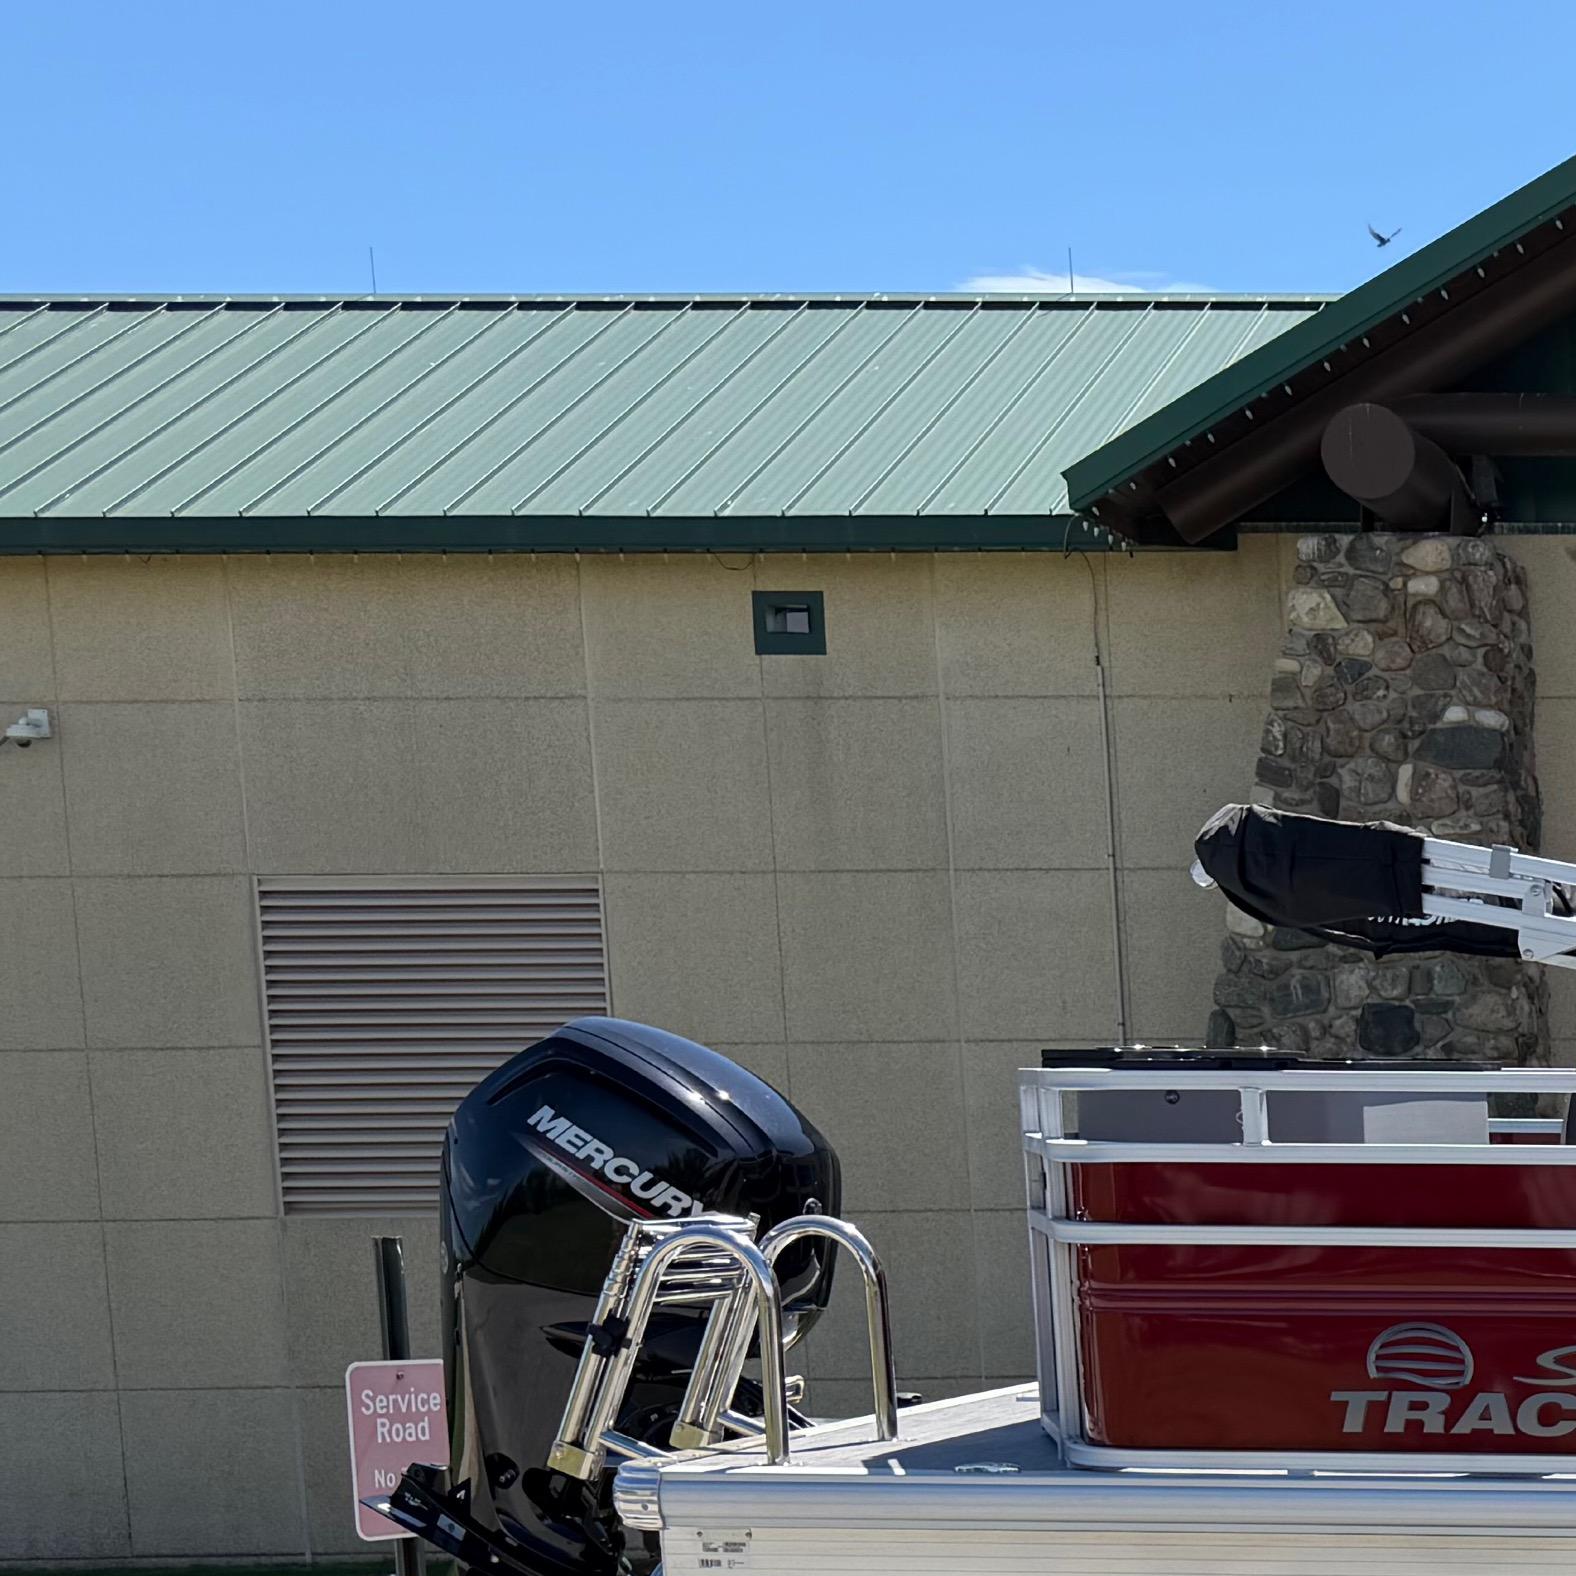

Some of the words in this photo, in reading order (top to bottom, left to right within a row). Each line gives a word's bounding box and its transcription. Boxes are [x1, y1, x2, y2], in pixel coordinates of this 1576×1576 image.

[361, 1387, 441, 1415] Service
[376, 1416, 430, 1443] Road
[374, 1469, 396, 1488] No
